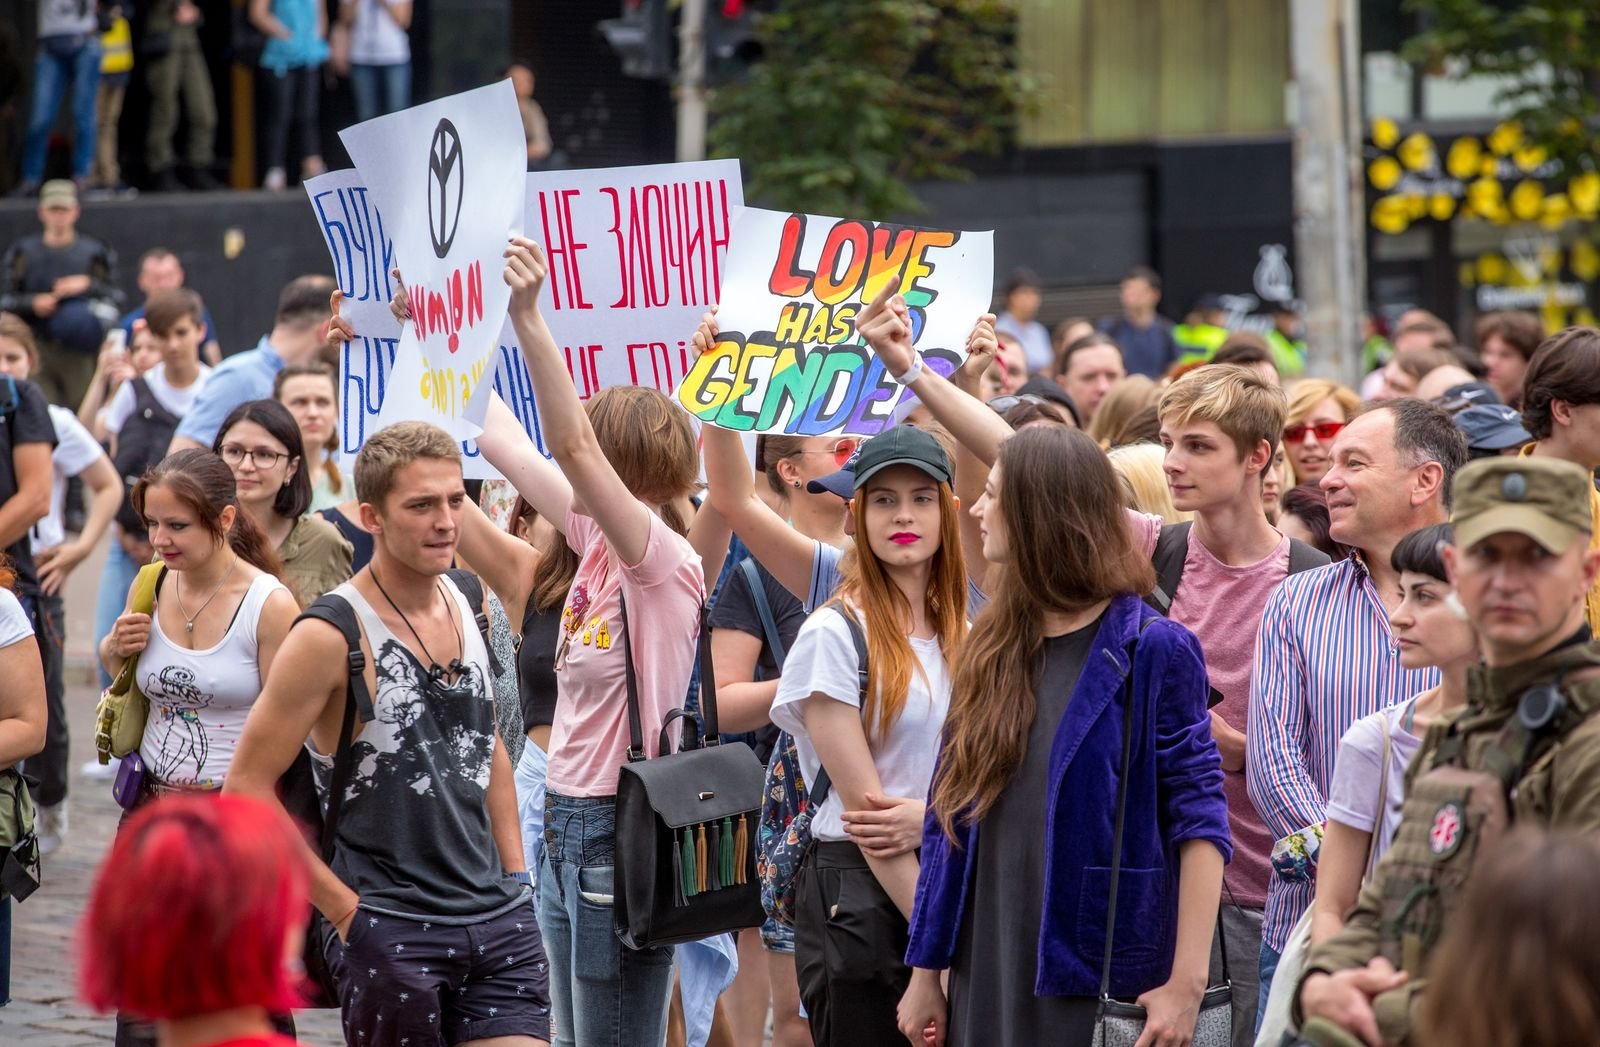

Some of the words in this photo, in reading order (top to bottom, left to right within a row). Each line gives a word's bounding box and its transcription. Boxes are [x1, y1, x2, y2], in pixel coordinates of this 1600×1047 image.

[538, 189, 593, 310] НЕ
[599, 179, 730, 309] ЗЛОЧИН
[768, 212, 961, 307] LOVE
[775, 301, 861, 345] HAS
